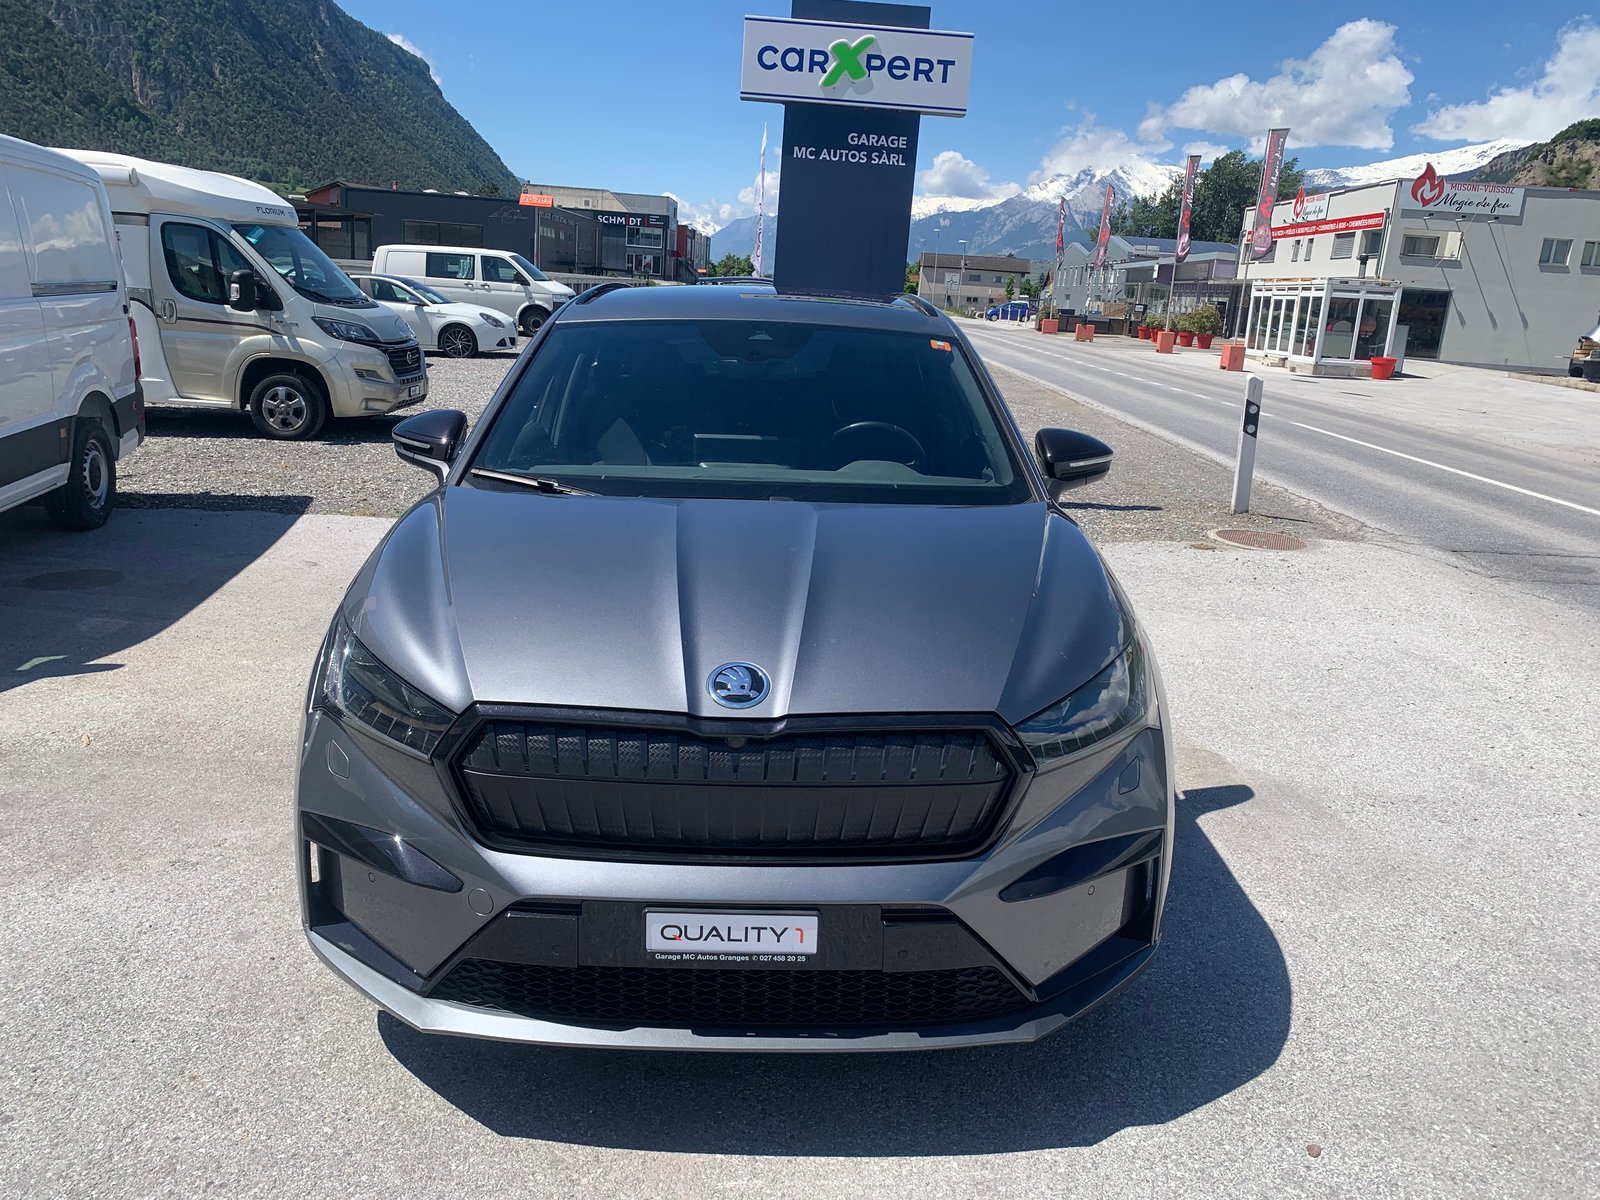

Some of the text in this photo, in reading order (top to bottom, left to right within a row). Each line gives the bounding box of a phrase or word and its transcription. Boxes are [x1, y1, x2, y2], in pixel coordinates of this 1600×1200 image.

[848, 133, 907, 149] GARAGE
[793, 146, 906, 166] MC AUTOS SÀRL
[1450, 182, 1515, 194] MOSONI-VUISSOZ
[1433, 192, 1511, 213] Magie du feu
[597, 213, 642, 226] SCHMIDT
[660, 924, 804, 944] QUALITY 1
[655, 953, 681, 961] Garage
[697, 953, 718, 961] Autos
[719, 954, 749, 962] Granges
